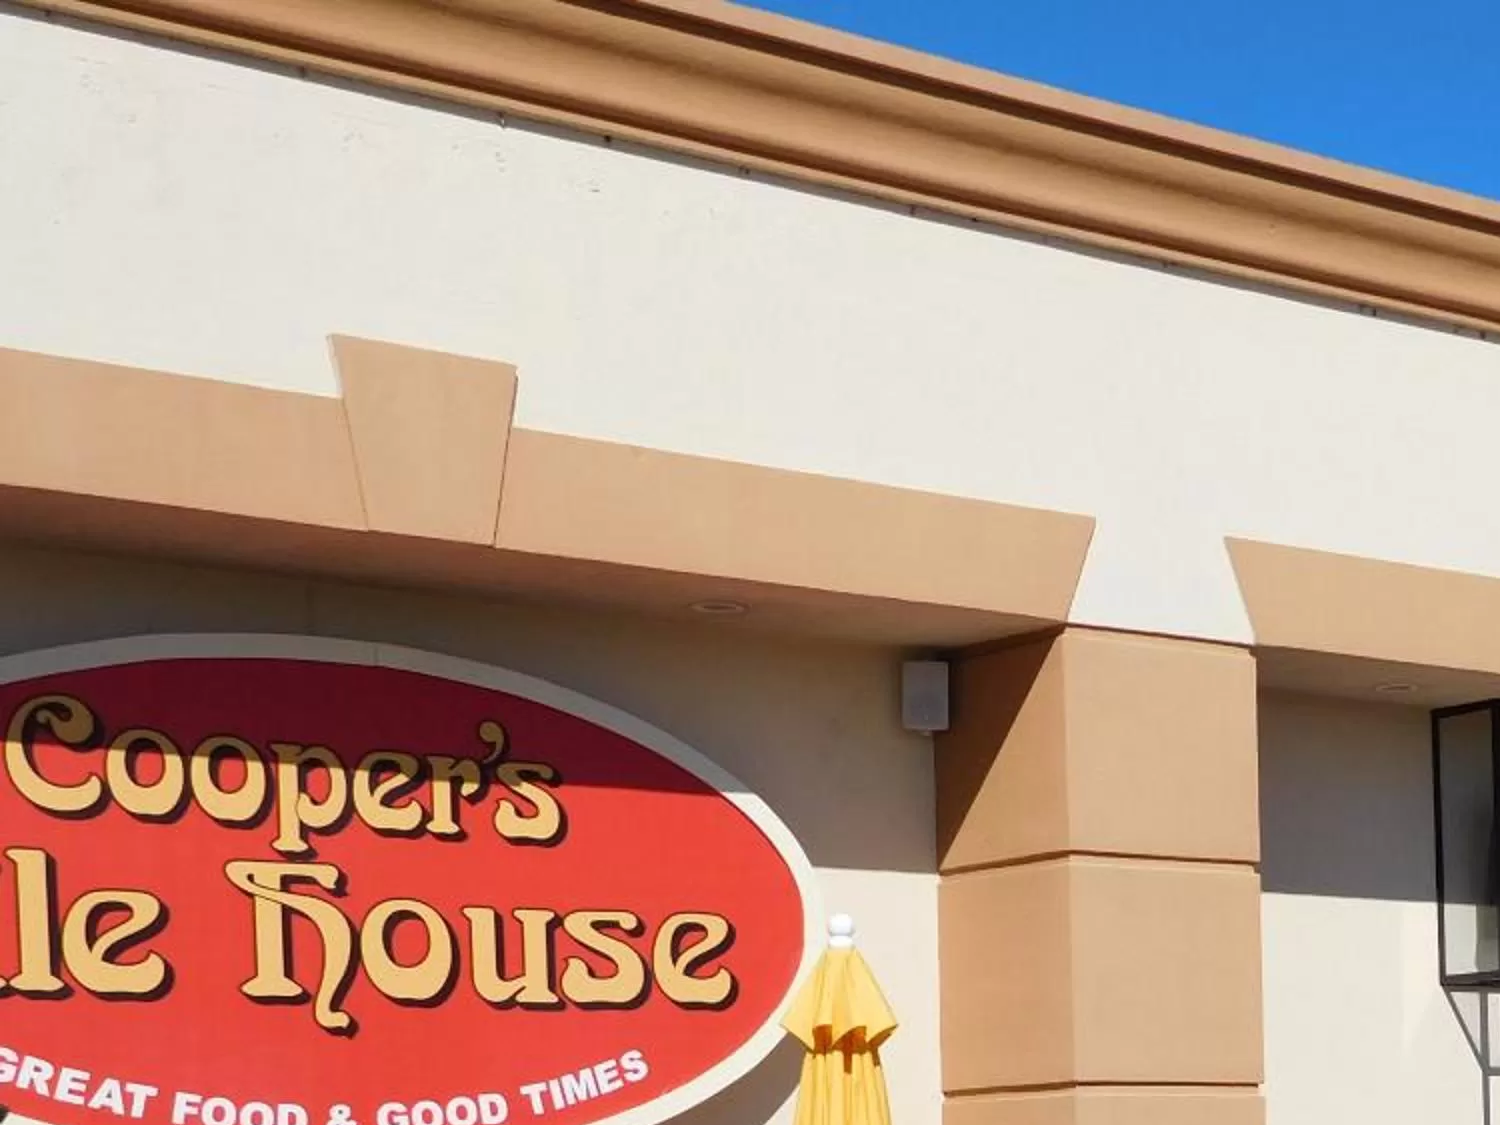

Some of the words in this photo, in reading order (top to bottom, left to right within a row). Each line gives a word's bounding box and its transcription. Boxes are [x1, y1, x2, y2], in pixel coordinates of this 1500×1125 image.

[4, 694, 569, 857] Cooper's
[0, 846, 174, 1001] le
[520, 1049, 650, 1116] TIMES
